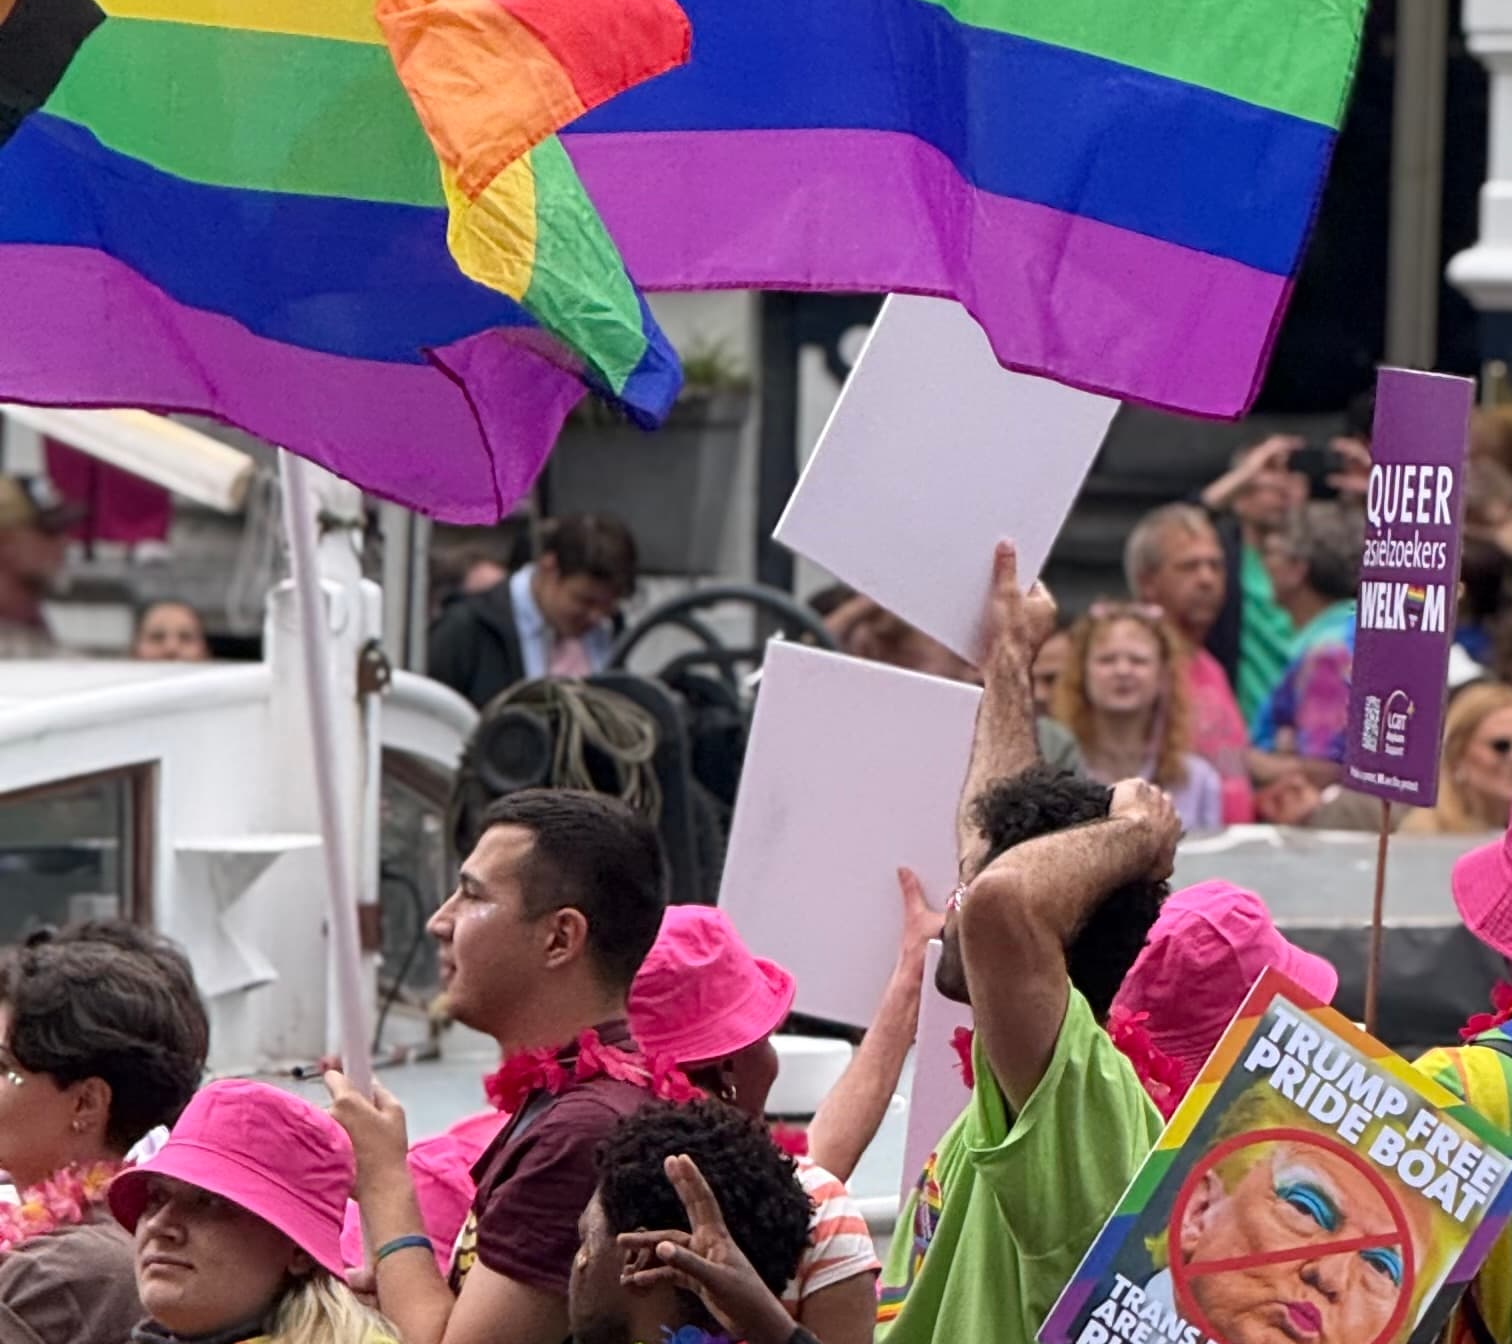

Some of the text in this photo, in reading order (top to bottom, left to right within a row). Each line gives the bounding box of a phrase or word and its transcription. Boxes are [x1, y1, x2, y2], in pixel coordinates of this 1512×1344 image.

[1363, 528, 1447, 570] asielzoekers
[1367, 464, 1453, 528] QUEER
[1243, 1036, 1486, 1223] PRIDE BOAT
[1266, 1006, 1502, 1194] TRUMP FREE
